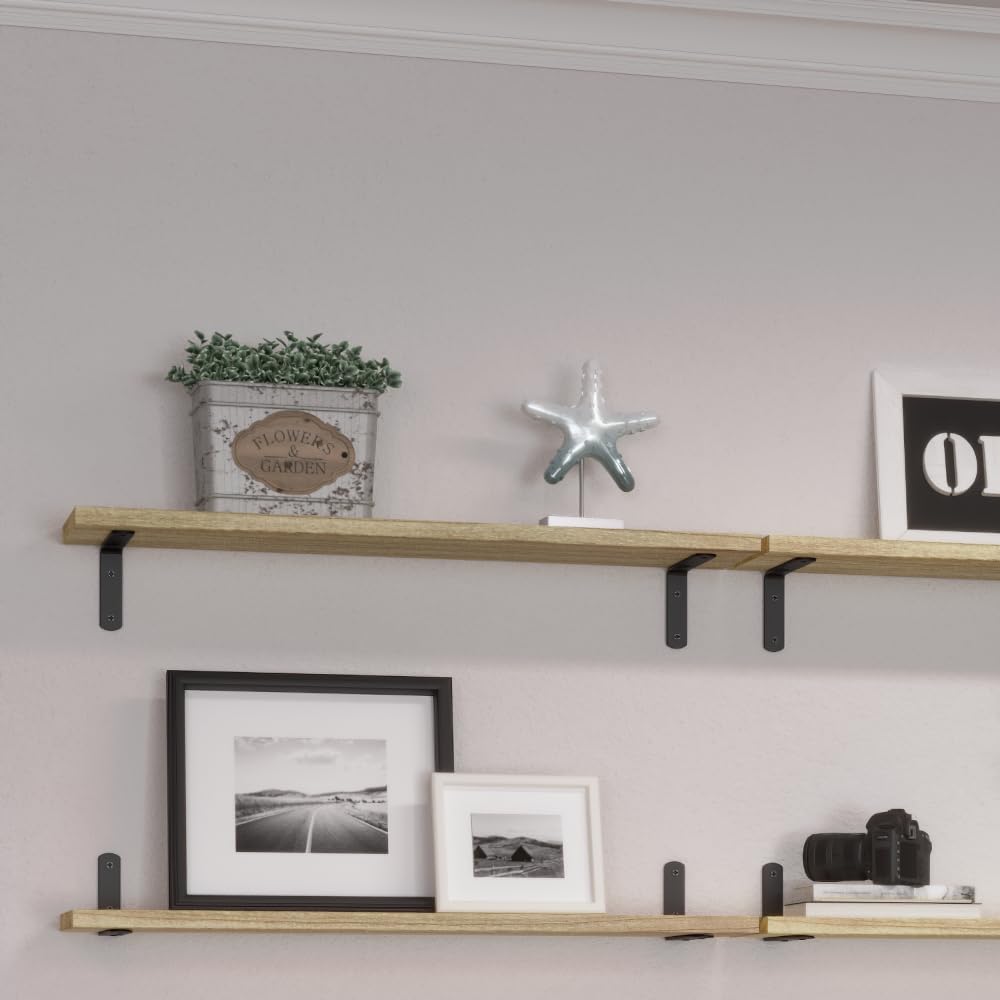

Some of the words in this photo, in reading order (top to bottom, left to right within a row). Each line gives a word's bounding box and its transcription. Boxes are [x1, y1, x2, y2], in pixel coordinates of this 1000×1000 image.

[252, 429, 335, 456] FLOWERS
[288, 445, 299, 458] &
[260, 459, 327, 475] GARDEN
